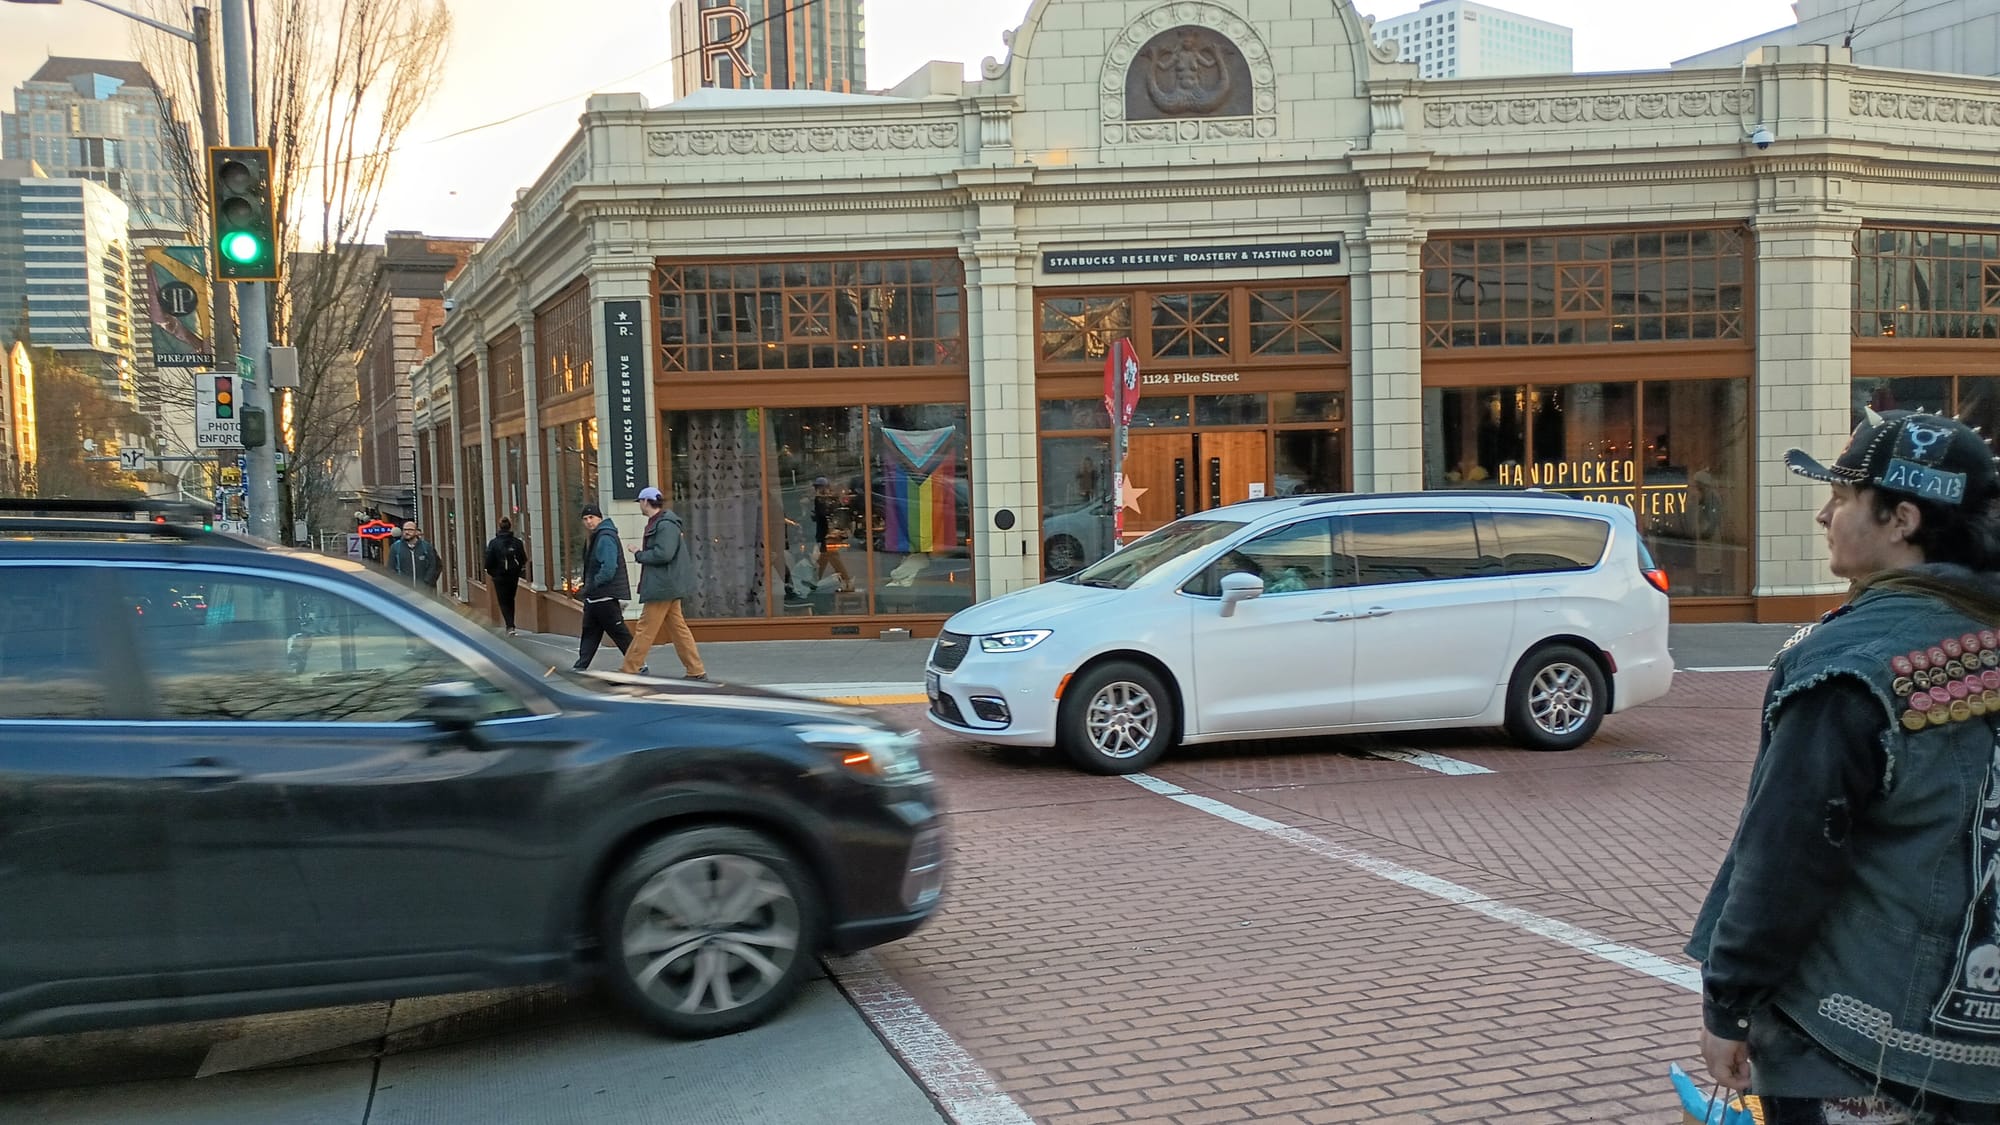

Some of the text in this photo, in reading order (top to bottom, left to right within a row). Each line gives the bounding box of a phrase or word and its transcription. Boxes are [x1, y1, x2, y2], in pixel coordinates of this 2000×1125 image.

[700, 5, 757, 82] R
[1049, 255, 1116, 267] STARBUCKS
[1183, 252, 1238, 262] ROASTERY
[1241, 251, 1249, 260] &
[1252, 250, 1297, 260] TASTING
[1300, 248, 1333, 259] ROOM
[156, 353, 211, 364] PIKE/PINE
[1142, 371, 1240, 385] 1124 Pike Street
[208, 422, 241, 431] PHOTO
[620, 355, 635, 489] STARBUCKS RESERVE
[199, 434, 241, 444] ENFORC
[1499, 460, 1634, 486] HANDPICKED
[1889, 465, 1963, 499] ACAB
